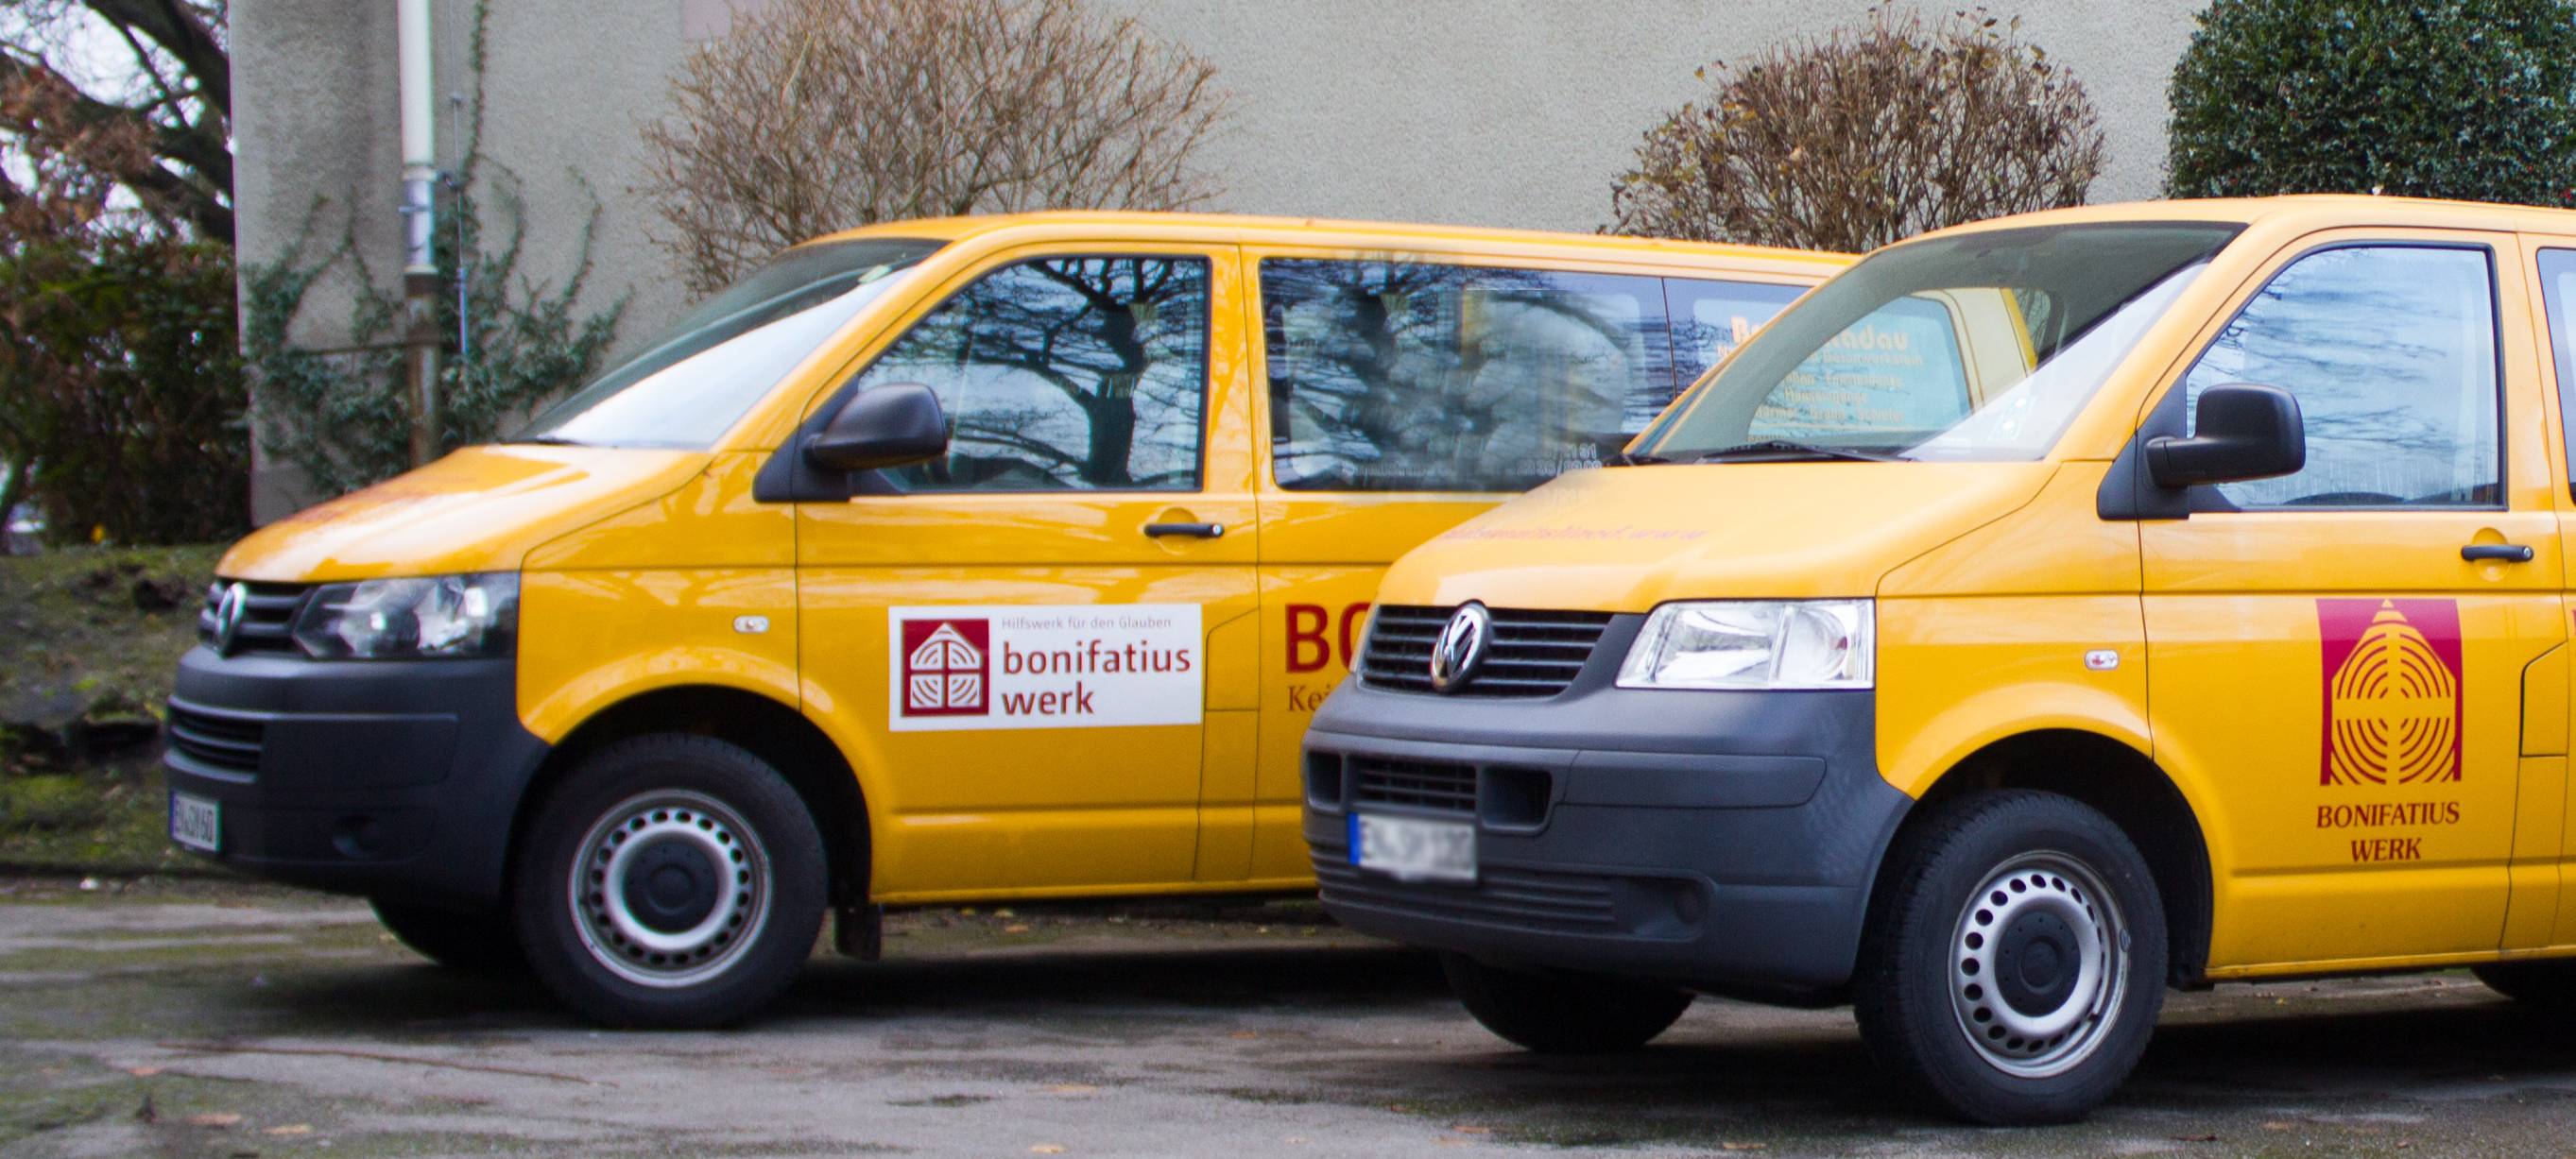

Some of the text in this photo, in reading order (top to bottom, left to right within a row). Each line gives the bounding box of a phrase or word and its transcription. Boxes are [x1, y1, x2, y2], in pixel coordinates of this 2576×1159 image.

[1002, 616, 1172, 630] Hilfswerk für den Glauben
[1003, 639, 1191, 674] bonifatius
[1002, 681, 1094, 715] werk
[2317, 801, 2461, 828] BONIFATIUS
[2350, 838, 2422, 862] WERK
